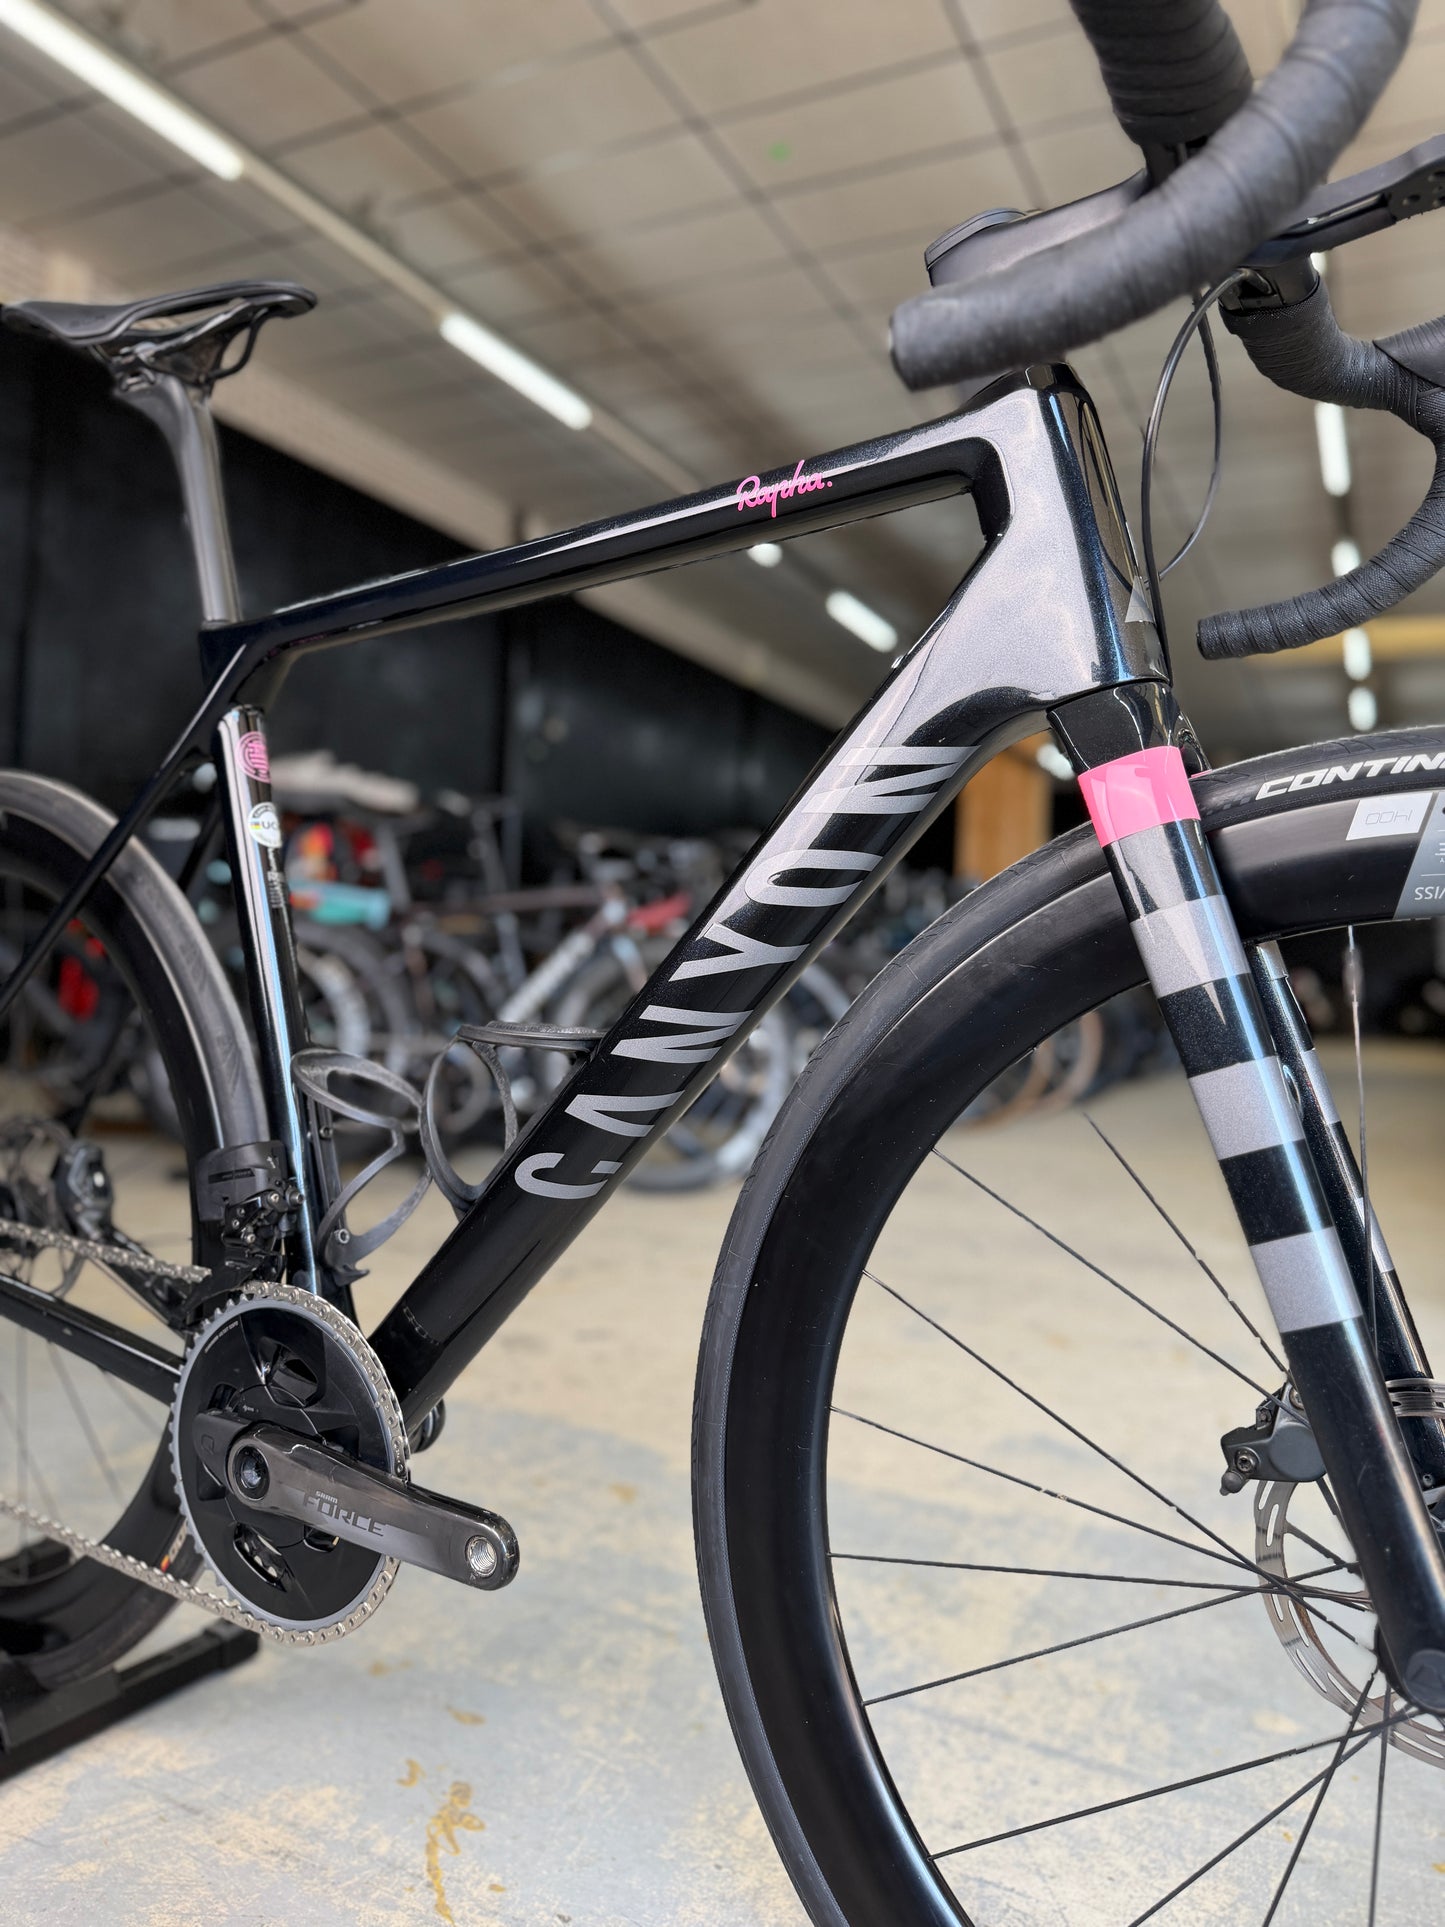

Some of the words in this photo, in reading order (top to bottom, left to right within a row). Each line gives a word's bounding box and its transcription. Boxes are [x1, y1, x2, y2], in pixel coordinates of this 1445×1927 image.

[1255, 751, 1445, 801] CONTIN
[513, 745, 981, 1200] CANYON
[303, 1492, 385, 1537] FORCE
